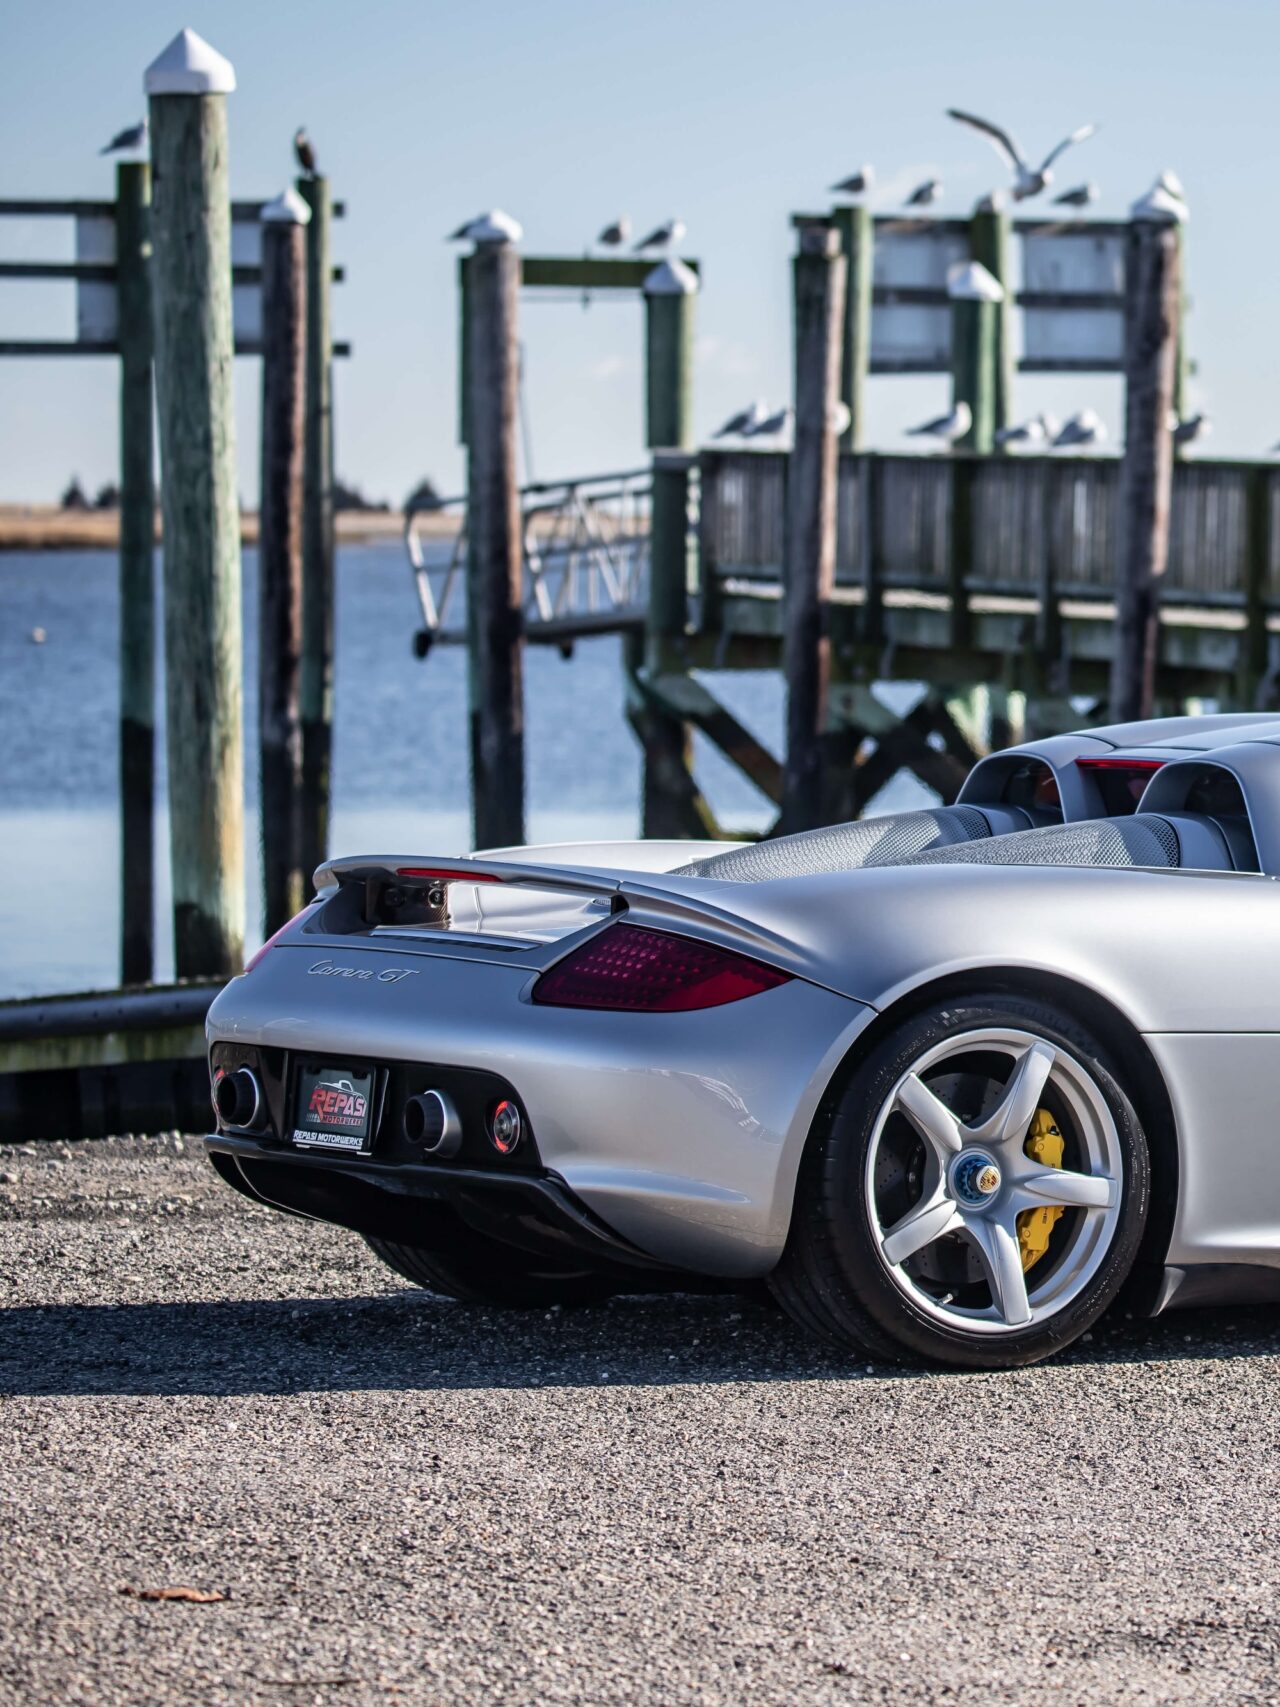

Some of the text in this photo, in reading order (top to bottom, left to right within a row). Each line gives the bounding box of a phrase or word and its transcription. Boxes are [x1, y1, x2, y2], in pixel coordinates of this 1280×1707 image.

[308, 959, 420, 983] Carrera GT
[309, 1087, 367, 1120] REPASI
[293, 1129, 363, 1146] REPASI MOTORWERKS
